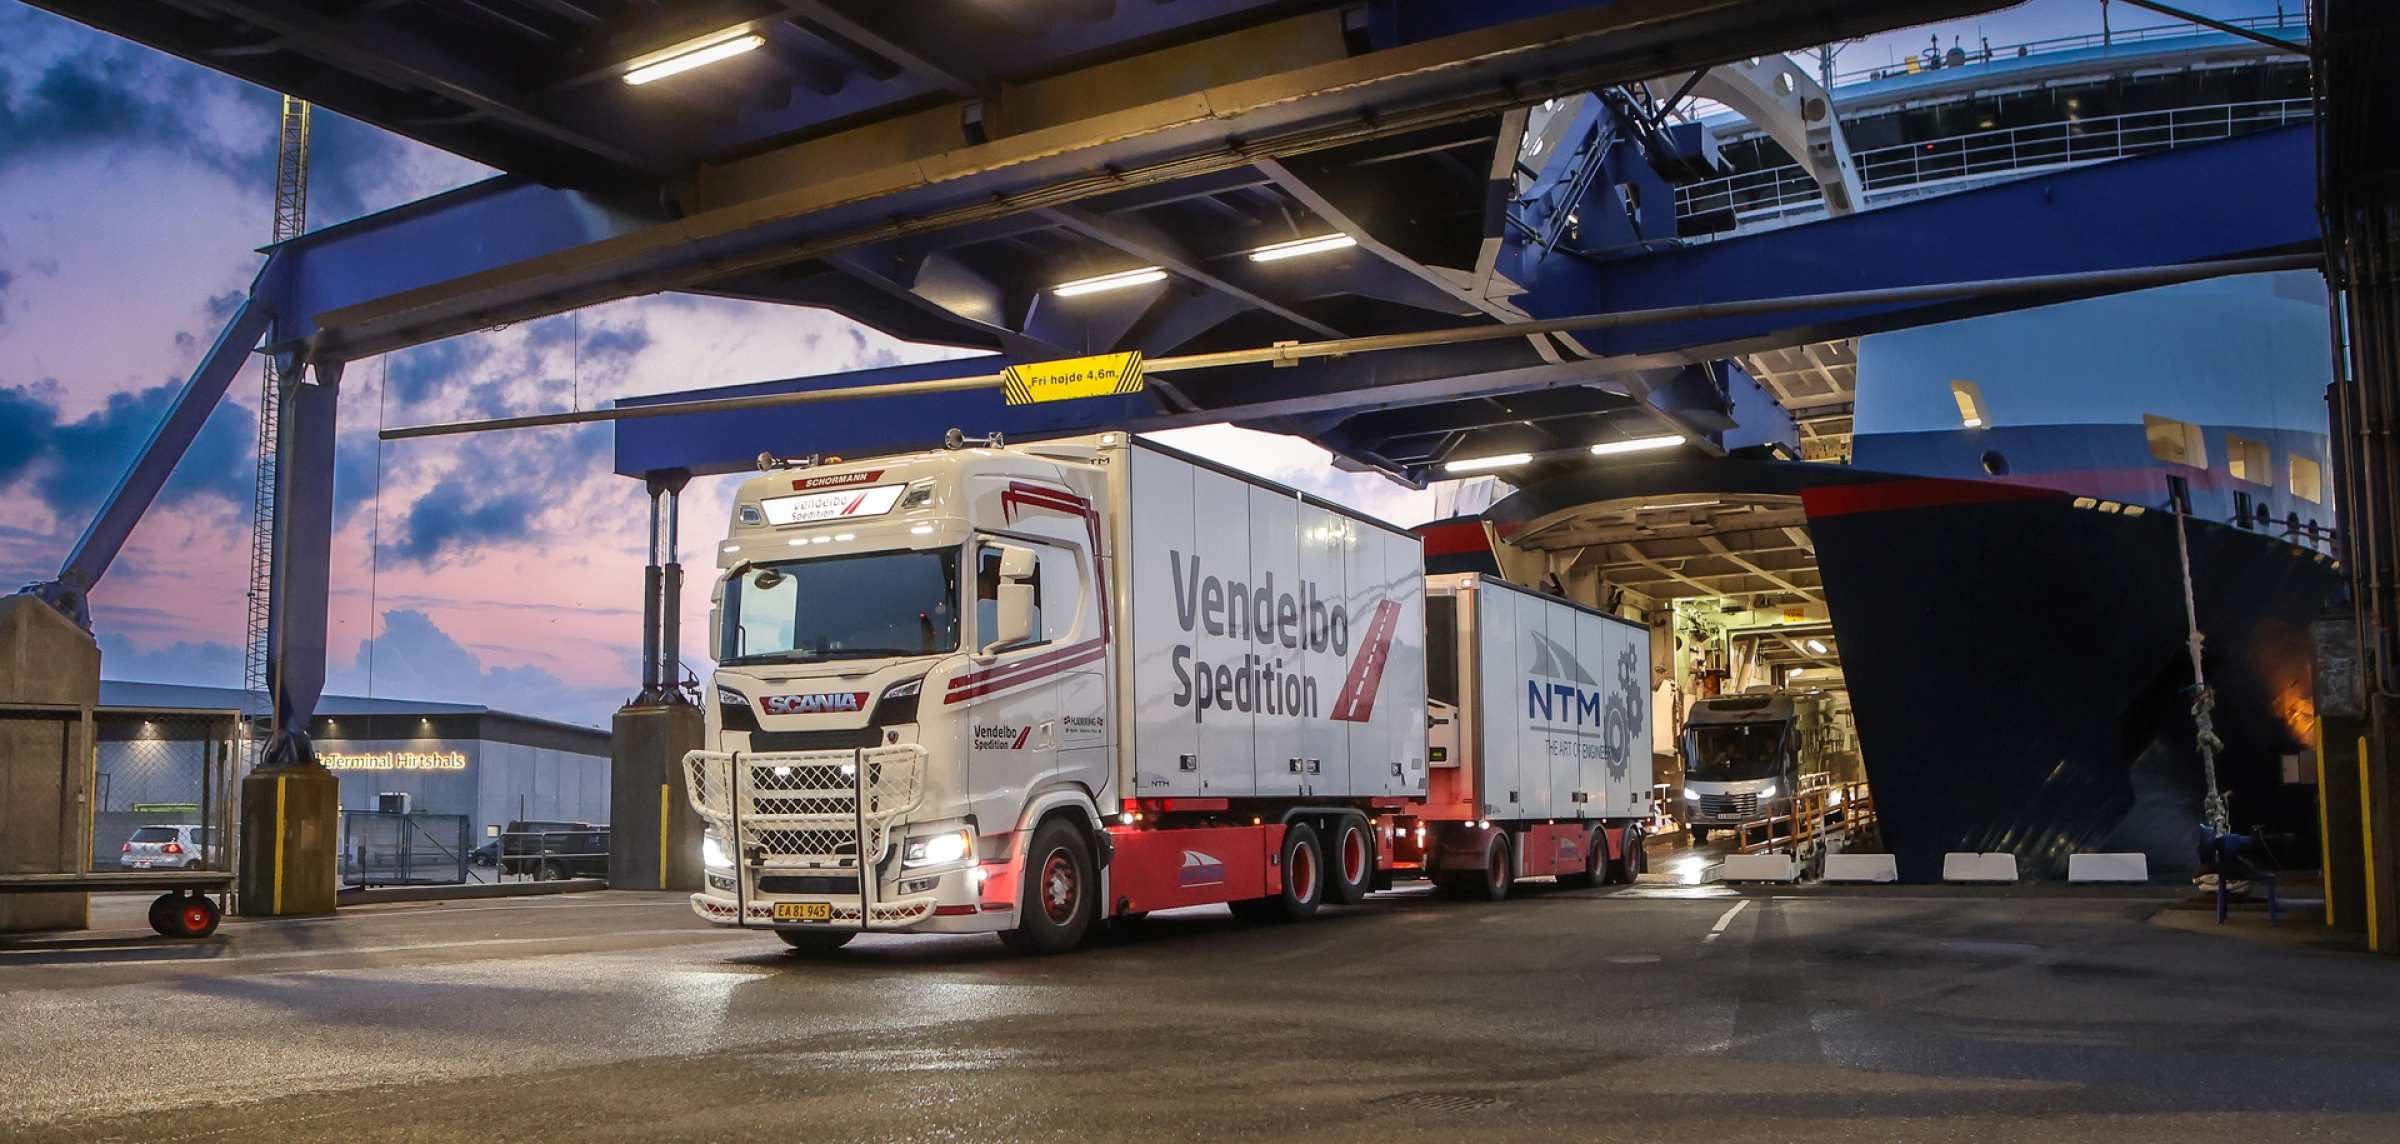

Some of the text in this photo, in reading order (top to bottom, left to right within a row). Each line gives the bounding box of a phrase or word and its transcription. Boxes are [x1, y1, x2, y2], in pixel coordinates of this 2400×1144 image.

[1031, 375, 1046, 387] Fri
[1050, 372, 1083, 386] højde
[805, 473, 868, 488] SCHORMANN
[794, 495, 848, 511] Vendelbo
[791, 508, 835, 521] Spedition
[1170, 549, 1348, 657] Vendelbo
[1172, 644, 1318, 724] Spedition
[768, 692, 859, 714] SCANIA
[1528, 679, 1601, 727] NTM
[974, 724, 1017, 739] Vendelbo
[974, 739, 1009, 751] Spedition
[1545, 739, 1559, 756] THE
[1559, 741, 1572, 756] ART
[396, 752, 466, 769] Hirtshals
[1151, 780, 1170, 788] NTM
[1180, 866, 1225, 885] NTM
[778, 904, 826, 917] EA 81 945
